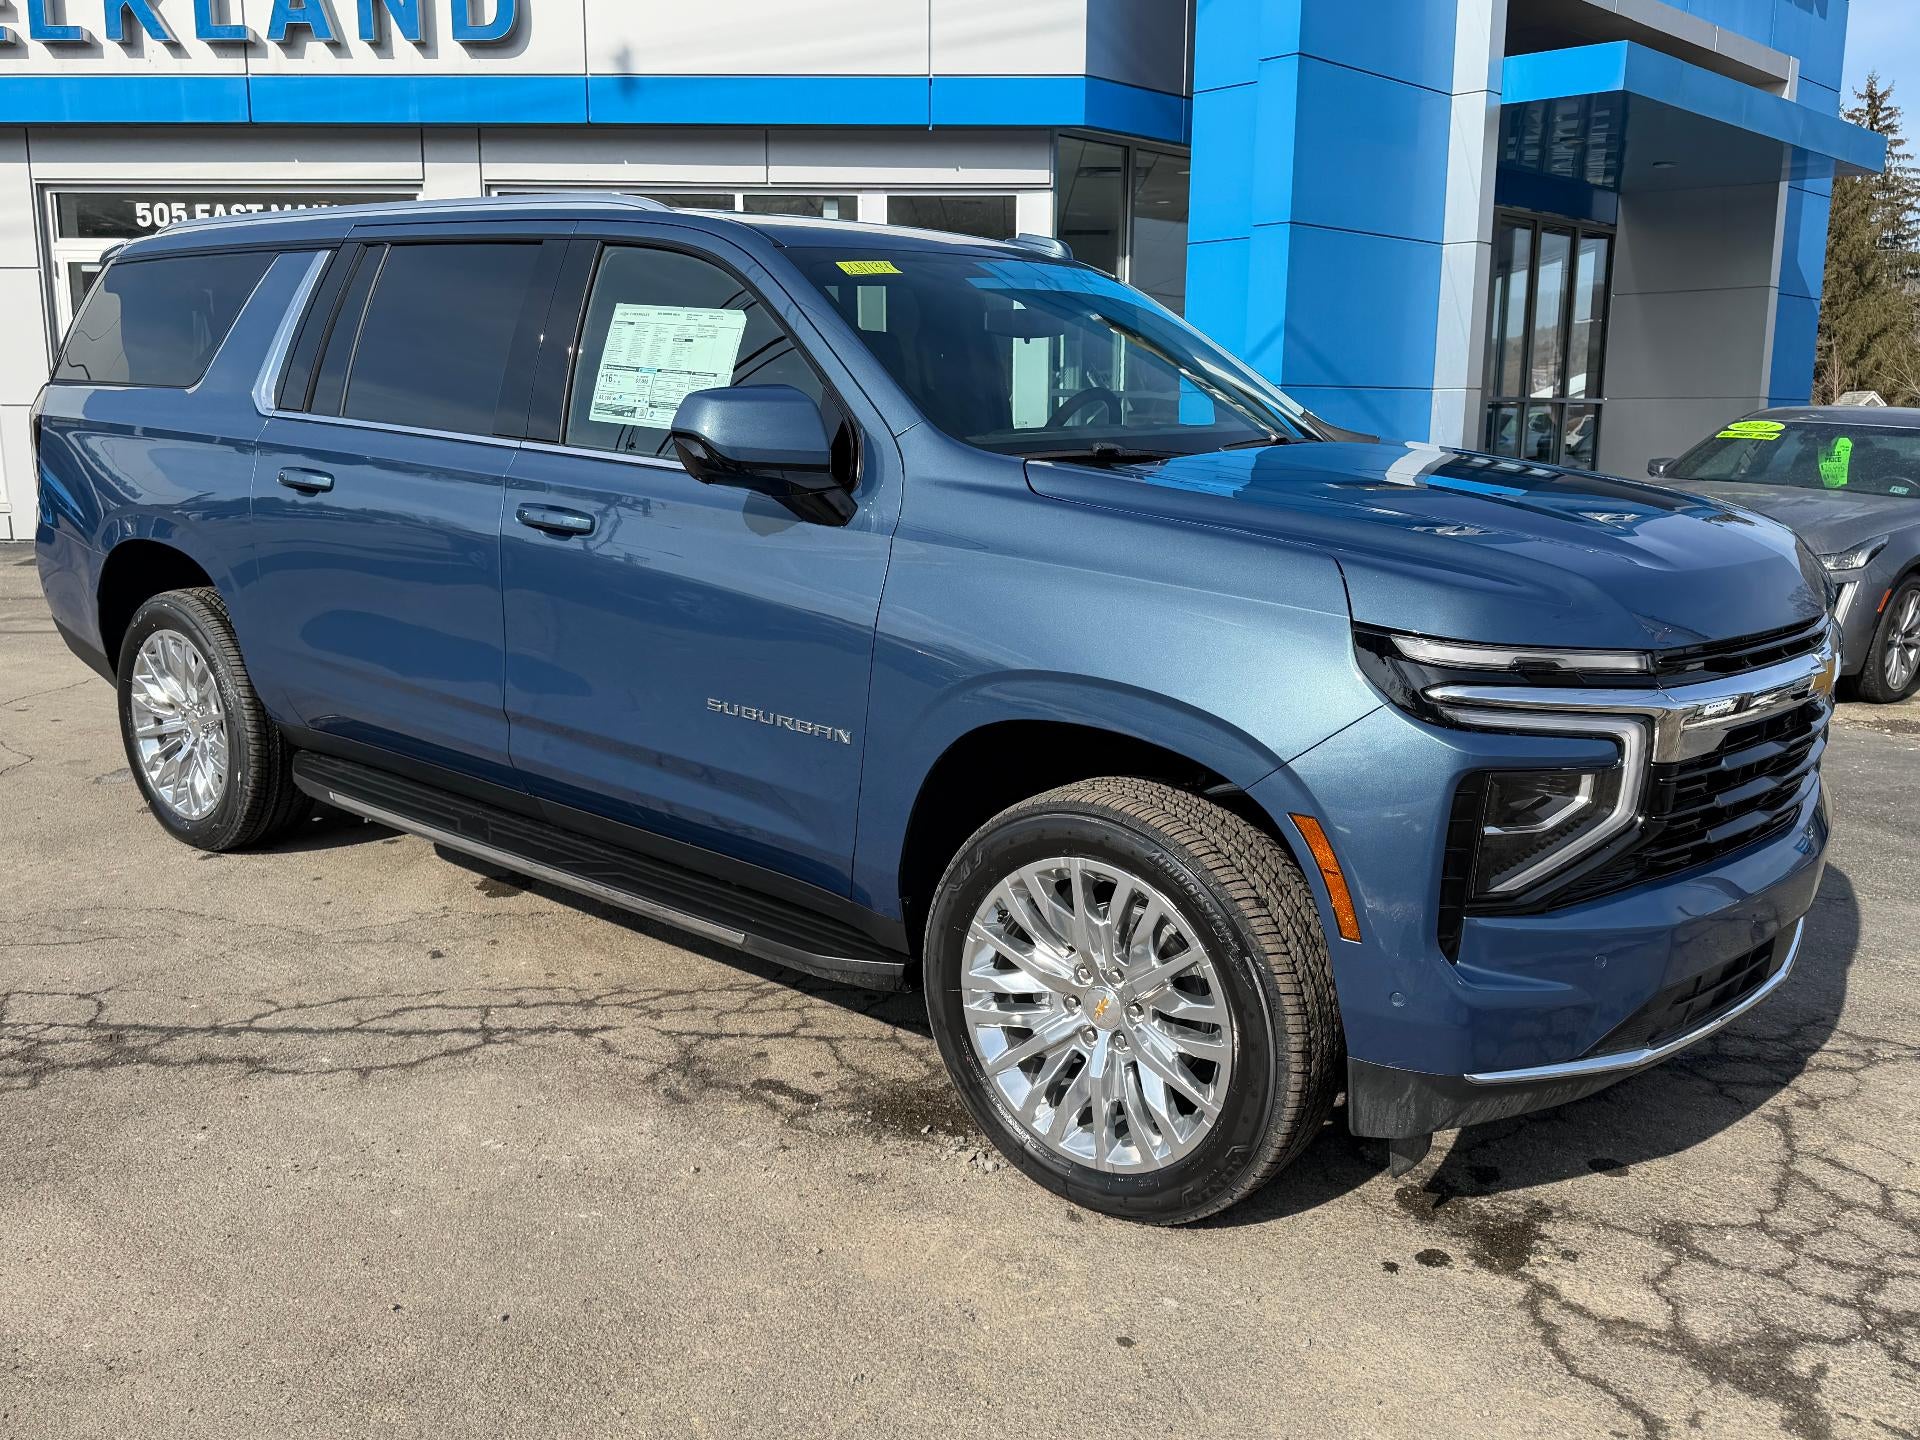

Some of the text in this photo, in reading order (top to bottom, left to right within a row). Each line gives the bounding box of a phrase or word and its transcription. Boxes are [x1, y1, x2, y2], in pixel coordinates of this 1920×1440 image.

[0, 0, 517, 42] LKLAND
[135, 202, 188, 227] 505
[707, 698, 853, 745] SUBURBAN
